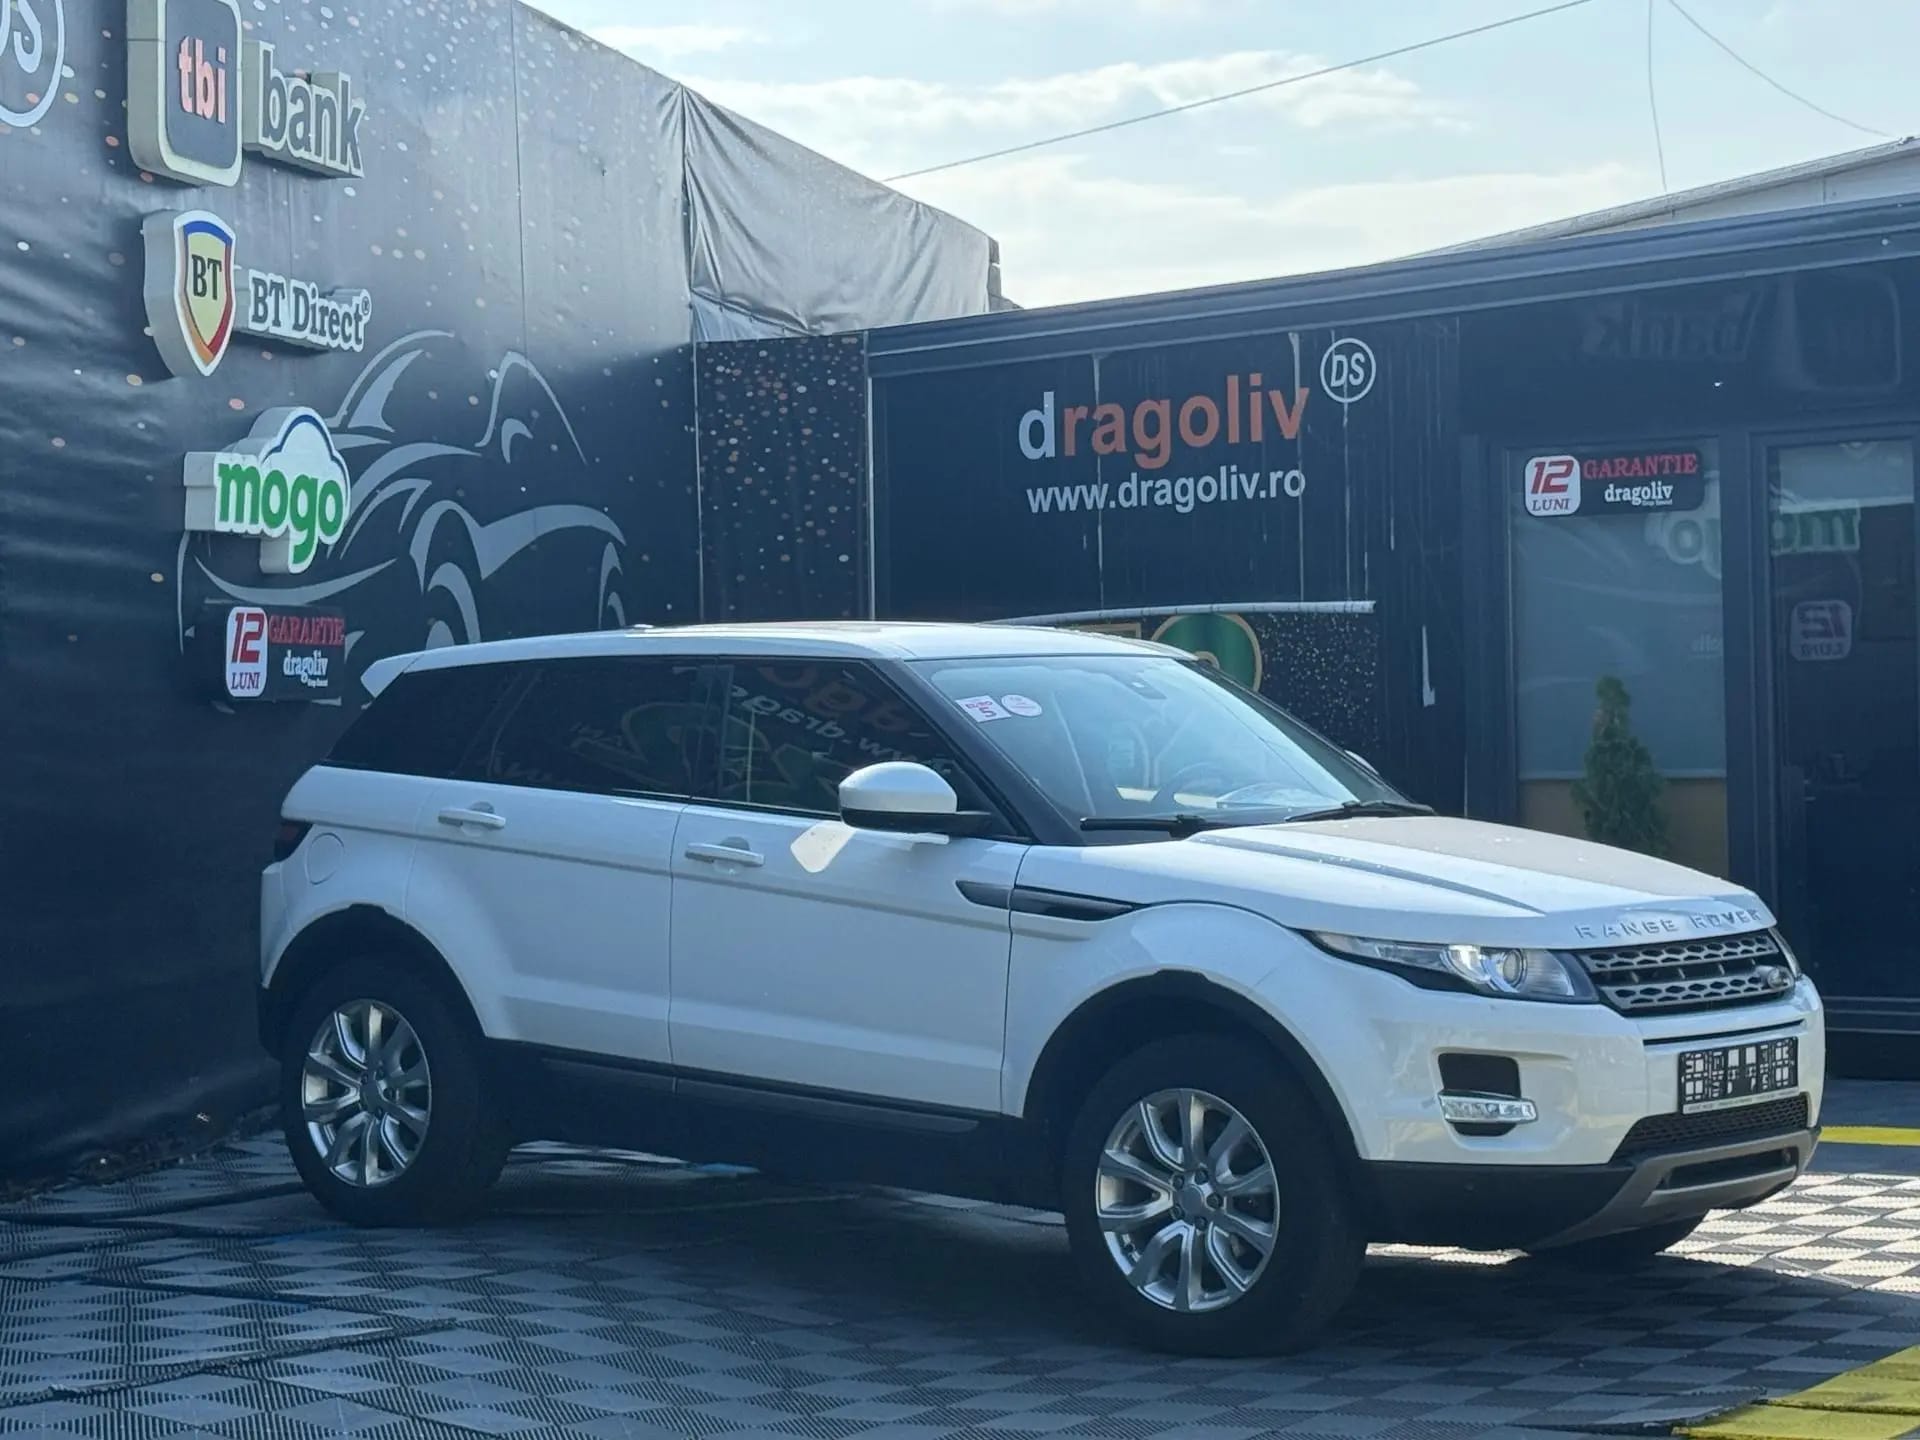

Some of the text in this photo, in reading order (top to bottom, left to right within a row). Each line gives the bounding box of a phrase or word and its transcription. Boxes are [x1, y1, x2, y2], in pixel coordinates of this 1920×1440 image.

[179, 36, 365, 172] tbi bank
[191, 254, 222, 300] BT
[251, 276, 285, 327] BT
[1329, 352, 1365, 388] DS
[1018, 373, 1310, 469] dragoliv
[1026, 465, 1306, 513] www.dragoliv.ro
[1531, 453, 1698, 494] 12 GARANTIE
[1604, 481, 1673, 506] dragoliv
[218, 463, 343, 564] mogo
[1532, 498, 1571, 512] LUNI
[231, 613, 345, 664] 12 GARANTIE
[231, 672, 260, 690] LUNI
[283, 649, 328, 683] dragoliv
[1575, 909, 1762, 940] RANGE ROVER
